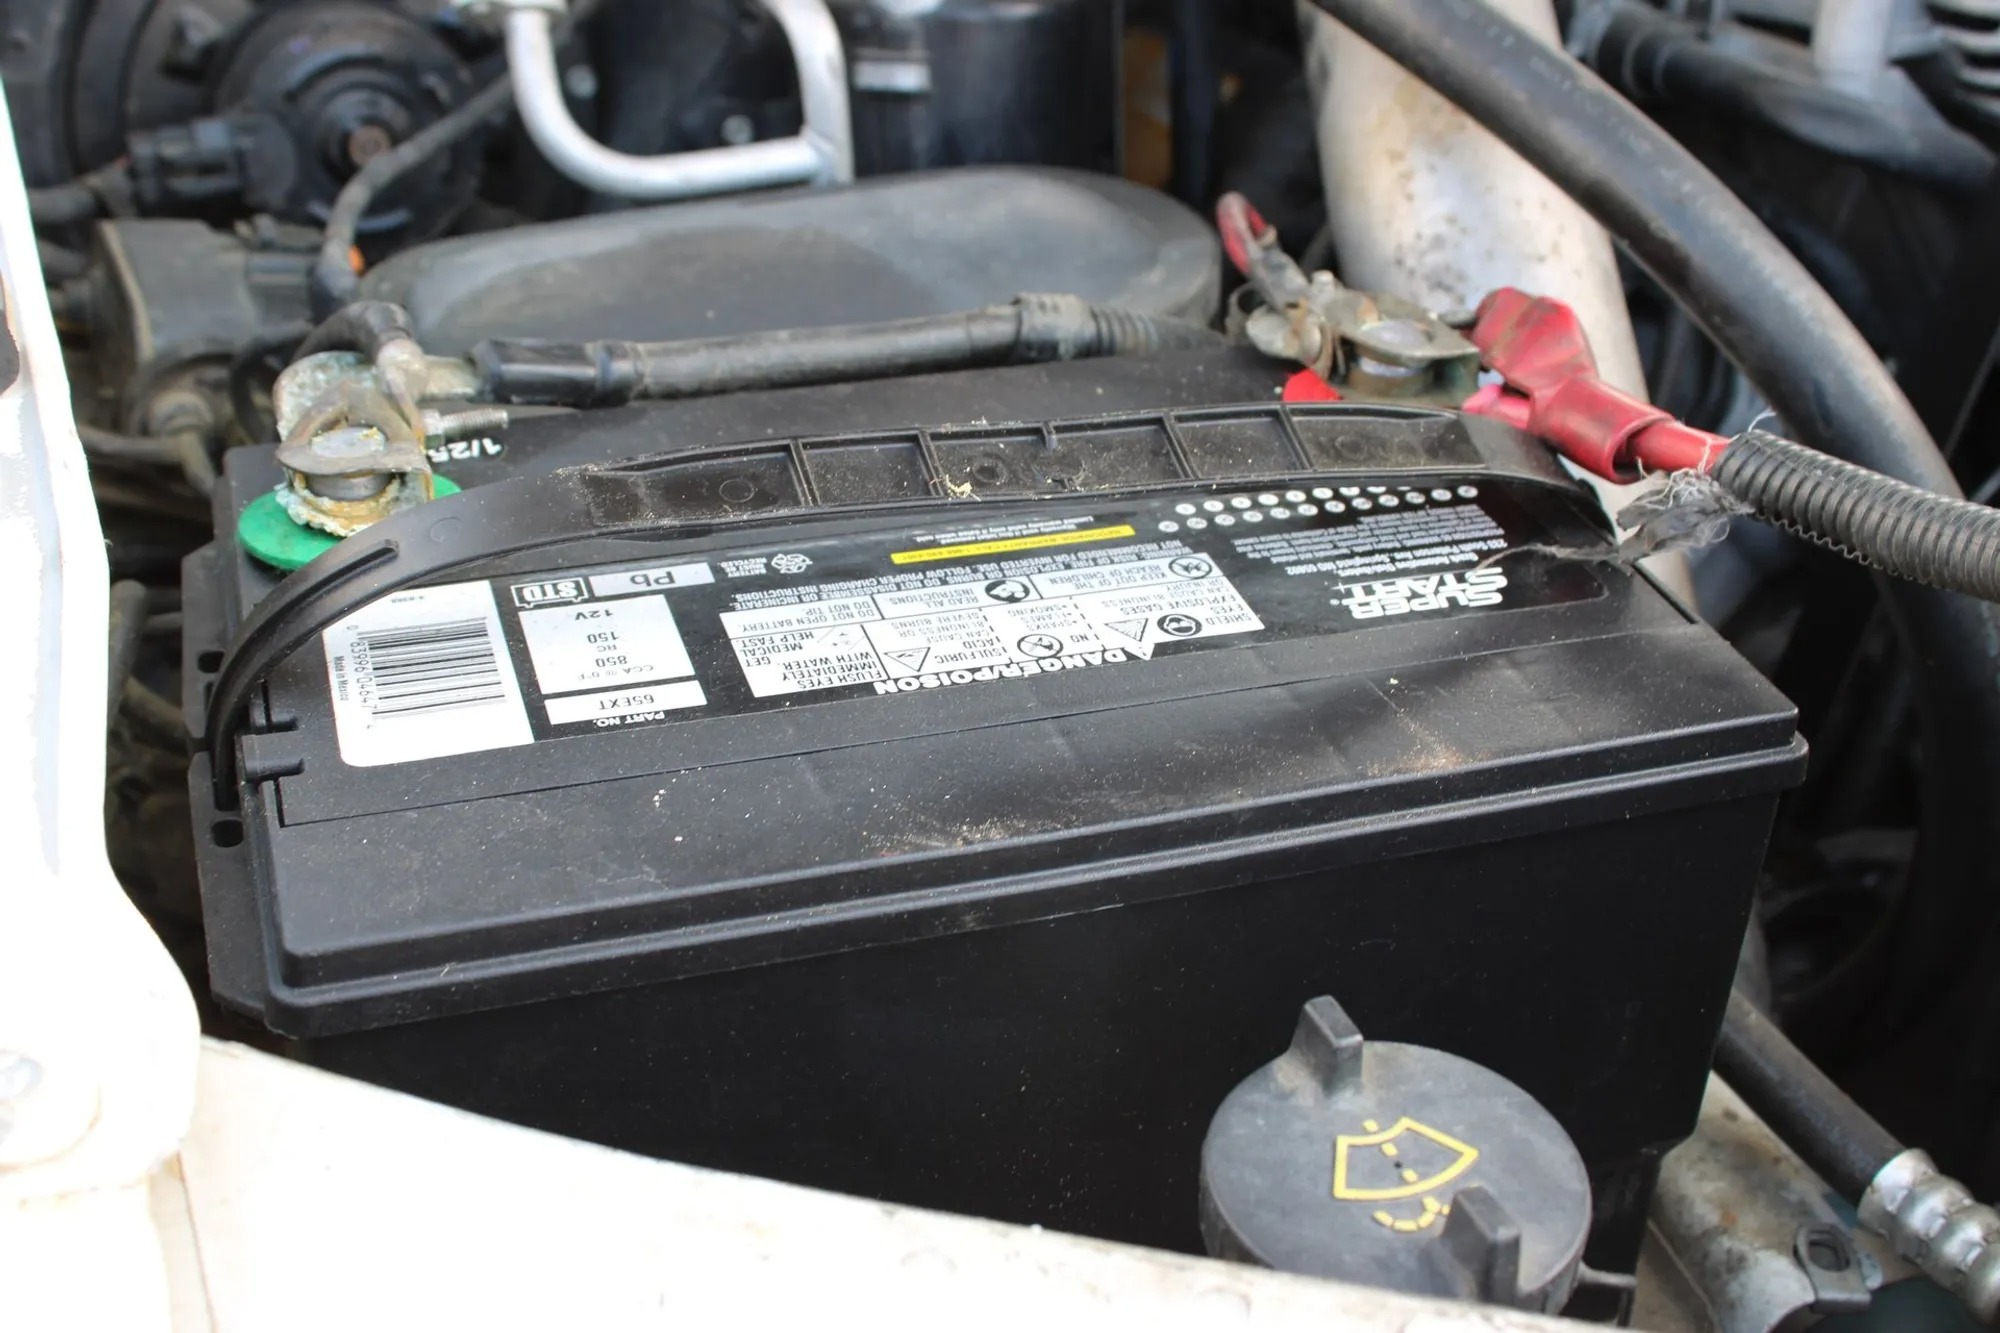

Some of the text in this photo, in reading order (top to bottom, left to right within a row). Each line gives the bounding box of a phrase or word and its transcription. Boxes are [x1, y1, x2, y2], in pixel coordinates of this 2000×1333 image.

[627, 570, 676, 589] Pb
[1341, 567, 1508, 603] START
[520, 580, 579, 602] STD
[825, 603, 851, 612] NOT
[852, 600, 870, 609] DO
[1117, 592, 1237, 616] EXPLOSIVE GASES
[1208, 602, 1245, 615] EYES
[1345, 588, 1503, 619] SUPER
[572, 608, 613, 620] 12V
[794, 614, 828, 625] OPEN
[829, 611, 855, 621] NOT
[856, 608, 875, 617] DO
[1203, 612, 1253, 626] SHIELD
[585, 630, 619, 644] 150
[734, 630, 815, 648] HELP FAST.
[960, 637, 996, 649] ACID
[1067, 633, 1090, 643] NO
[738, 641, 803, 657] MEDICAL
[932, 647, 1002, 664] SULFURIC
[593, 654, 628, 668] 850
[742, 655, 772, 667] GET
[775, 651, 873, 671] WITH WATER.
[779, 659, 878, 681] IMMEDIATELY
[871, 648, 1129, 695] DANGER/POISON
[795, 669, 883, 689] FLUSH EYES
[595, 693, 655, 710] 65EXT
[591, 710, 666, 728] PART NO.
